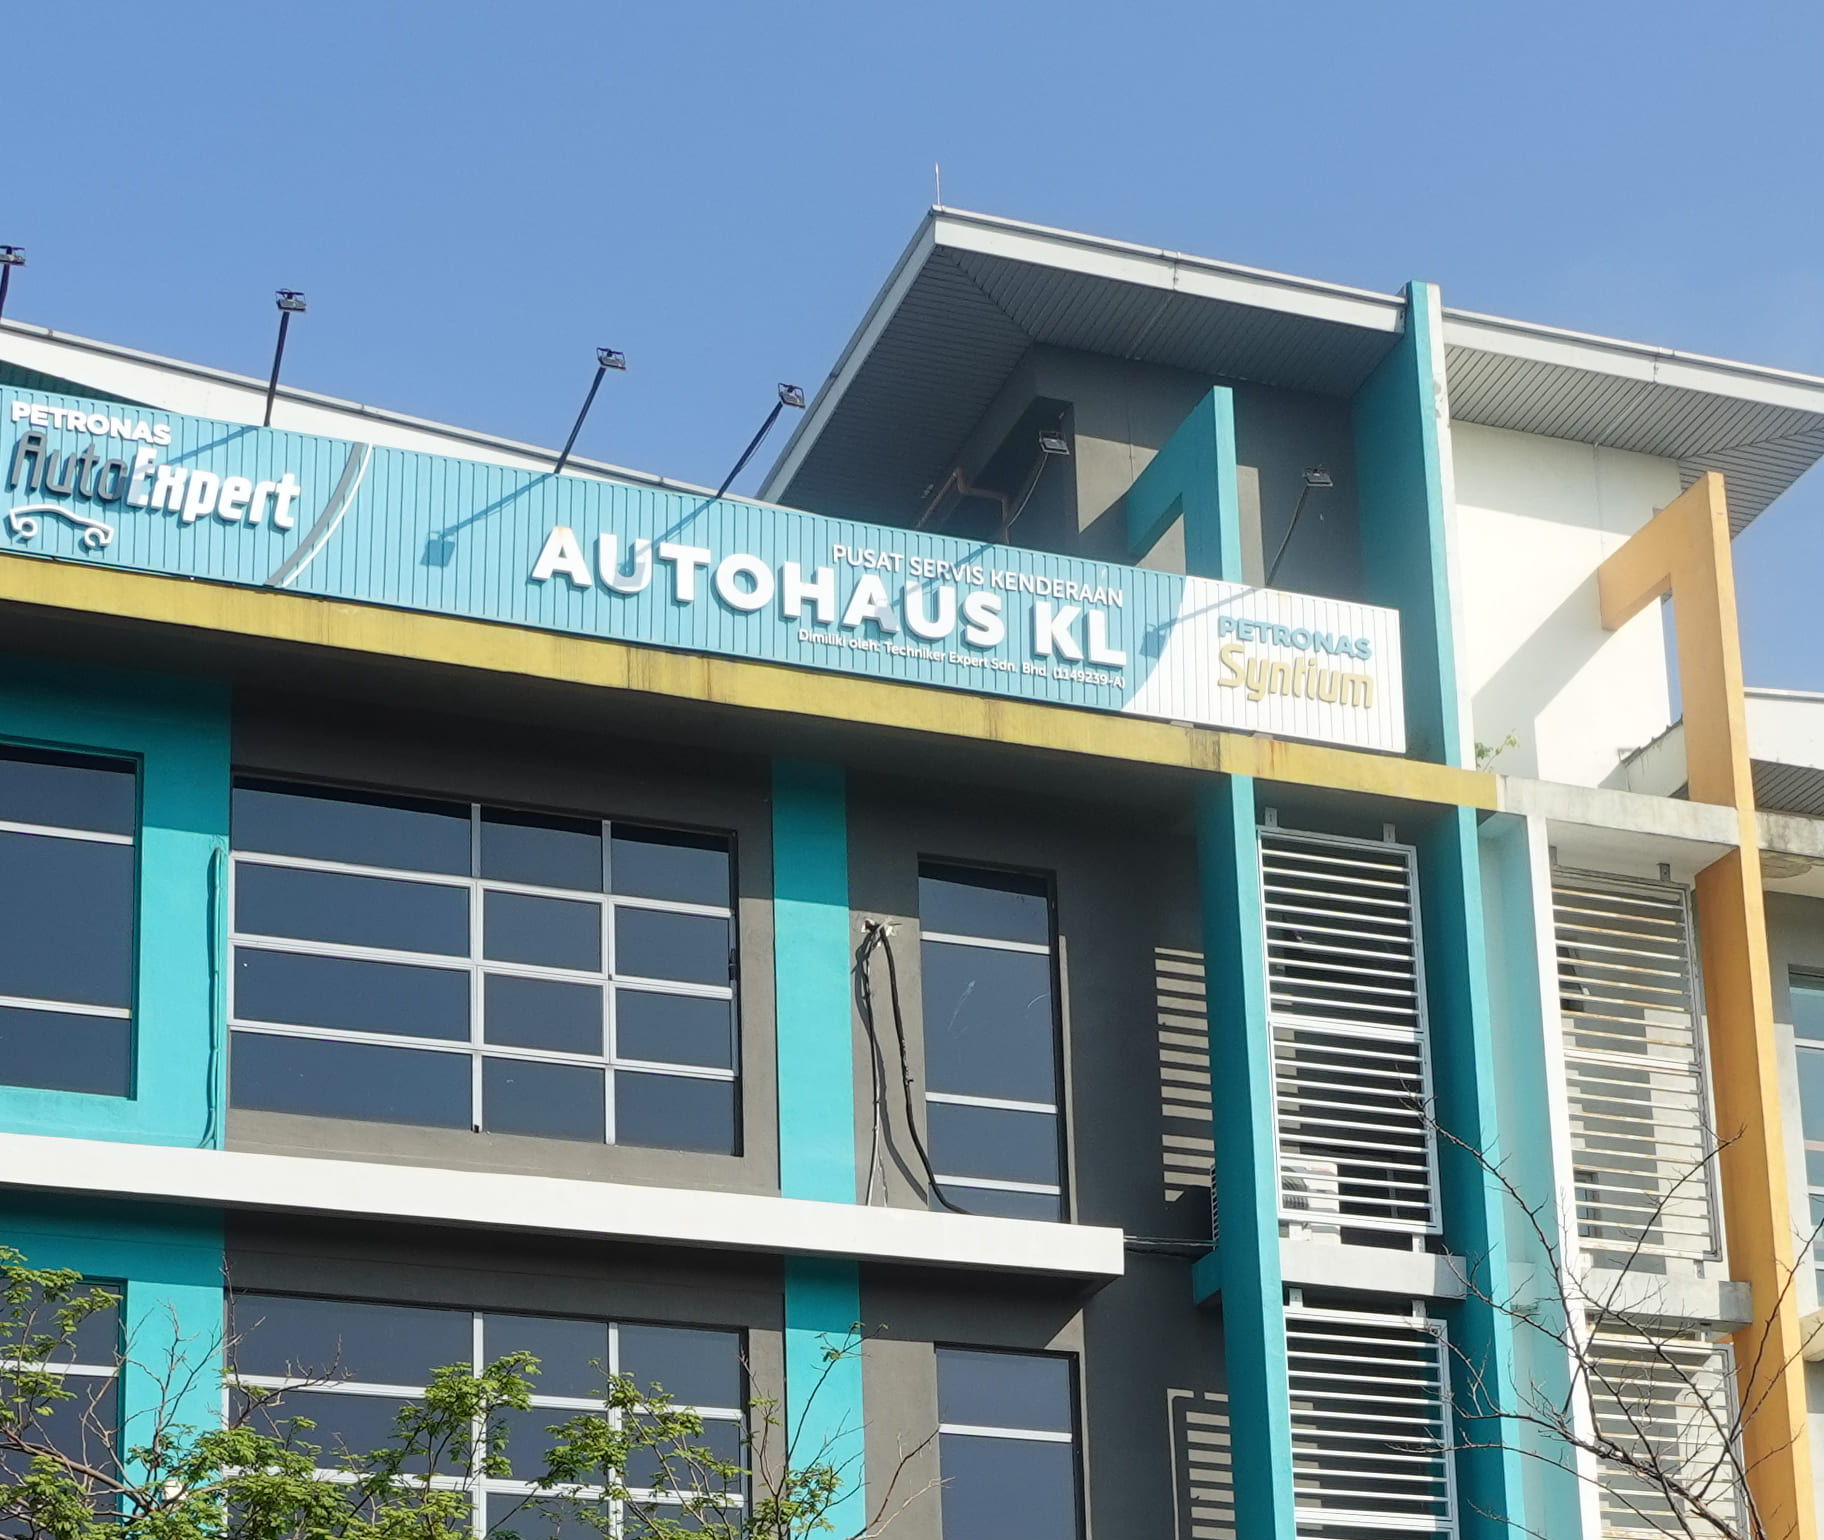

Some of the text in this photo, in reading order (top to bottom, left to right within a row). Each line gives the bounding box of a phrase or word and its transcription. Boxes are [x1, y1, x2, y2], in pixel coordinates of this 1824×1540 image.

[11, 401, 172, 446] PETRONAS
[8, 431, 301, 530] AutoExpert
[531, 525, 1127, 667] AUTOHAUS KL
[833, 544, 1124, 608] PUSAT SERVIS KENDERAAN
[798, 628, 846, 648] Dimiliki
[849, 635, 881, 652] oleh:
[884, 640, 946, 663] Techniker
[948, 650, 988, 671] Expert
[990, 657, 1017, 674] Sdn.
[1215, 614, 1373, 661] PETRONAS
[1215, 643, 1374, 709] Syntium
